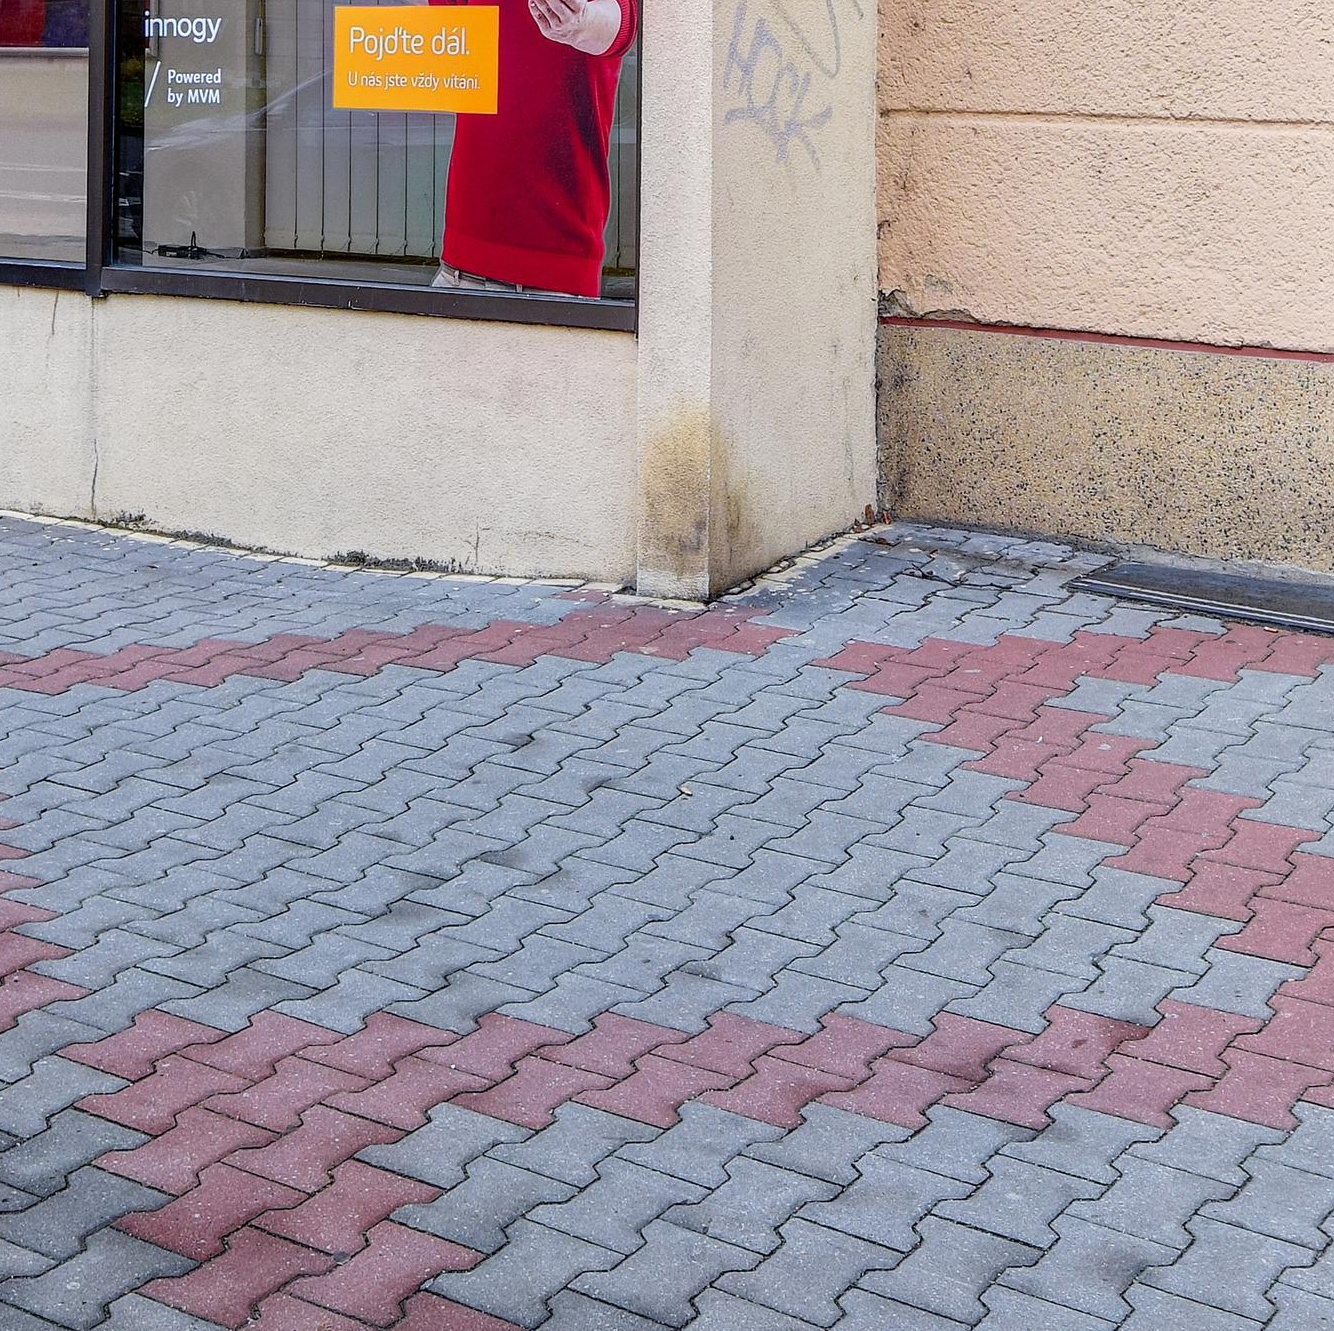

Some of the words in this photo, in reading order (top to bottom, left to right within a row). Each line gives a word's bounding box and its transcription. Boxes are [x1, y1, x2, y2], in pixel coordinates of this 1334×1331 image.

[144, 10, 222, 43] innogy
[349, 26, 424, 61] Pojďte
[431, 26, 470, 55] dál.
[167, 69, 222, 85] Powered
[347, 71, 358, 86] U
[361, 71, 382, 87] nás
[384, 72, 408, 90] jste
[411, 72, 440, 92] vždy
[443, 74, 482, 90] vítáni.
[167, 88, 184, 107] by
[187, 89, 221, 104] MVM
